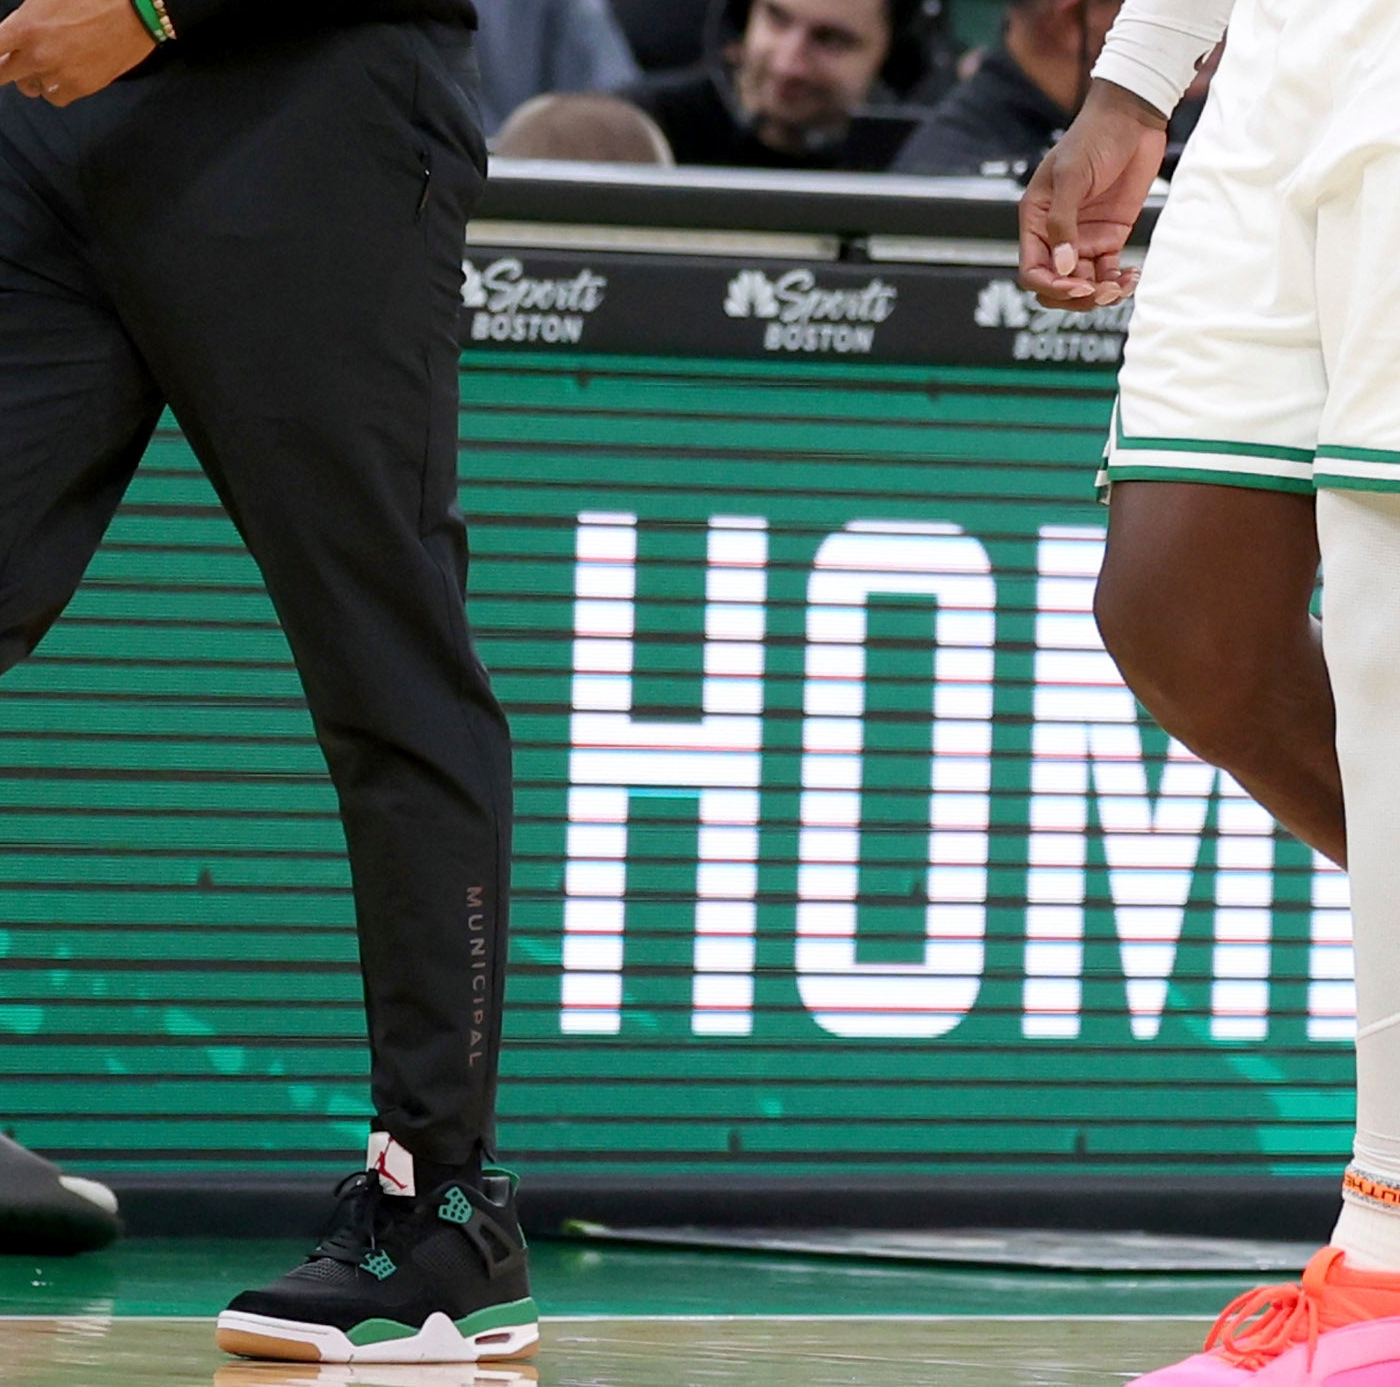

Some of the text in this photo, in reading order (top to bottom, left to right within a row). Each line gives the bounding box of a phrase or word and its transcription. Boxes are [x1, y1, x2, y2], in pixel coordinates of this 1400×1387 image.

[484, 257, 607, 314] Sports
[776, 268, 898, 322] Sports
[471, 312, 584, 344] BOSTON
[764, 321, 875, 352] BOSTON
[1012, 331, 1124, 363] BOSTON
[466, 886, 486, 1068] MUNICIPAL
